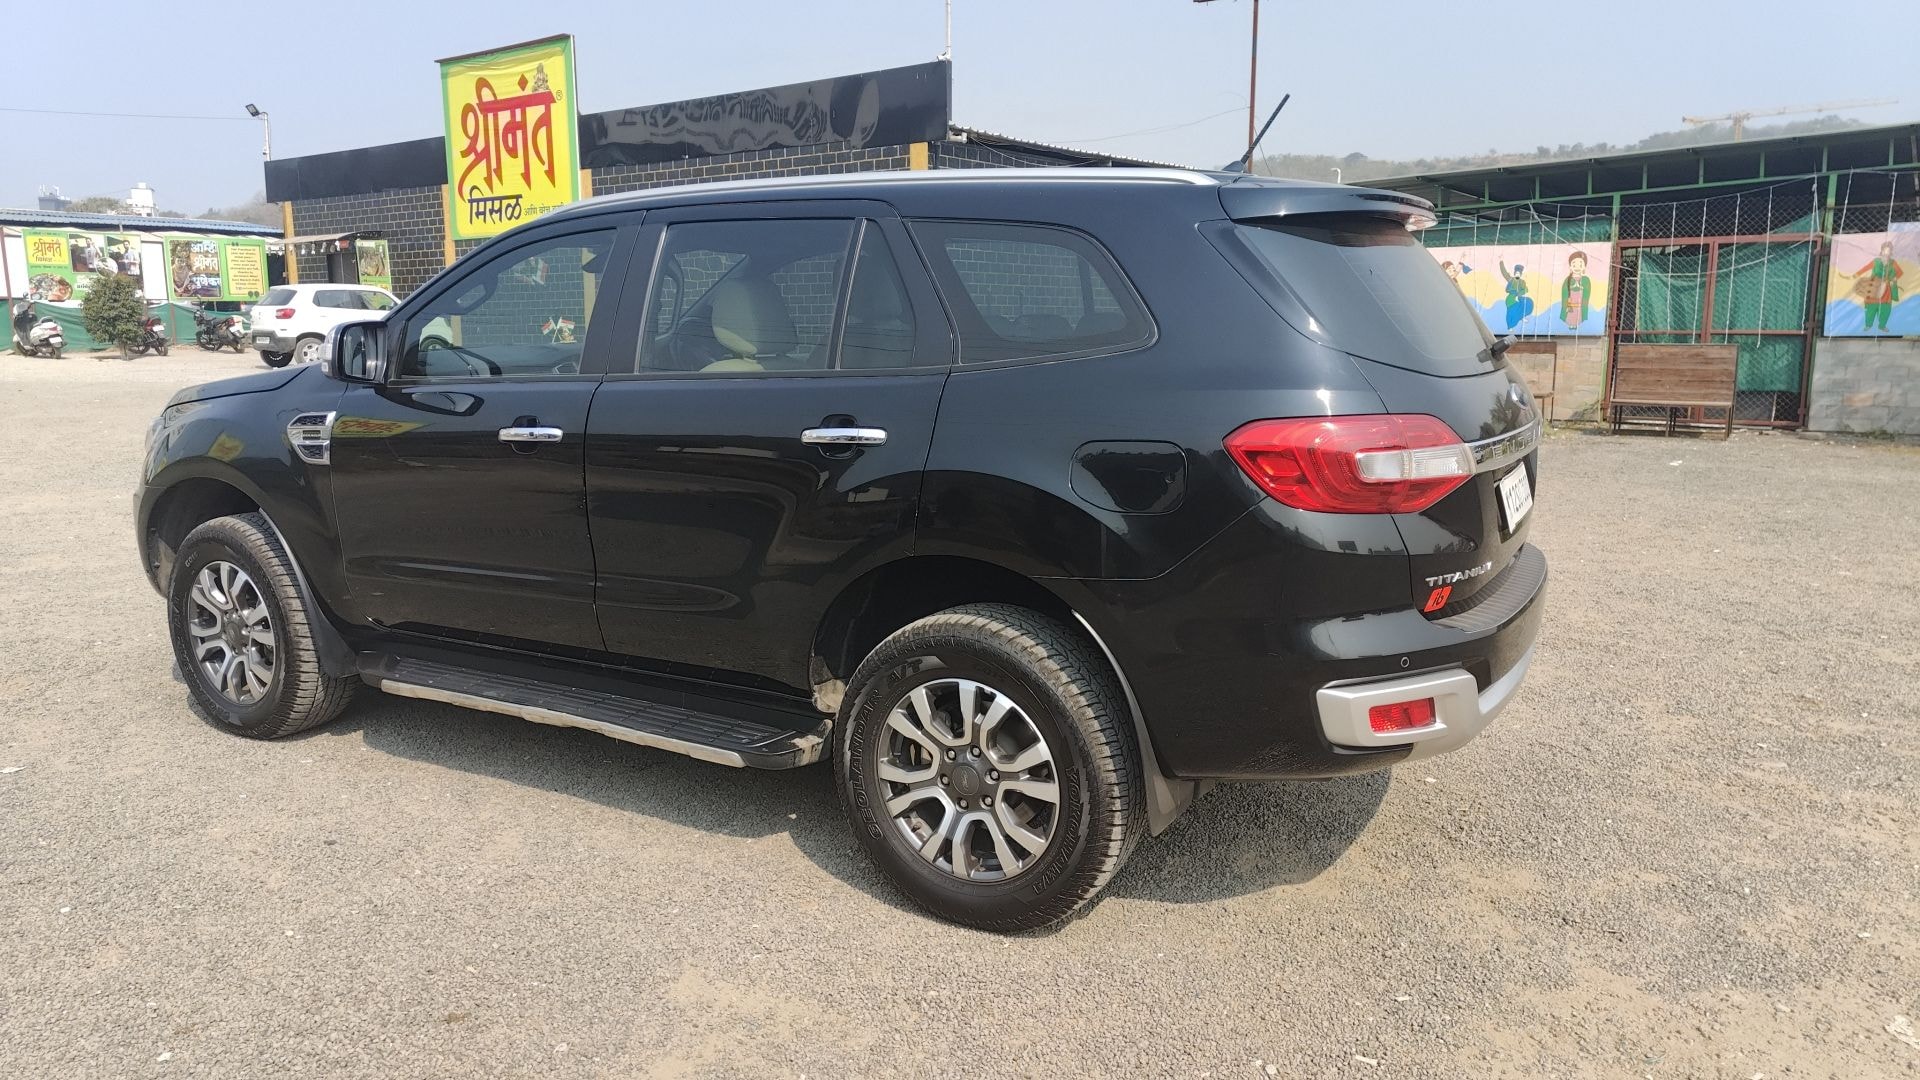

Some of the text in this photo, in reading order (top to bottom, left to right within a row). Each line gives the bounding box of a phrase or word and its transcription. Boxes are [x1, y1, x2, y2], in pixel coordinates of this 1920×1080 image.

[458, 73, 557, 203] श्रीमंत
[468, 185, 523, 225] मिसळ
[850, 688, 884, 840] GEOLANDAR
